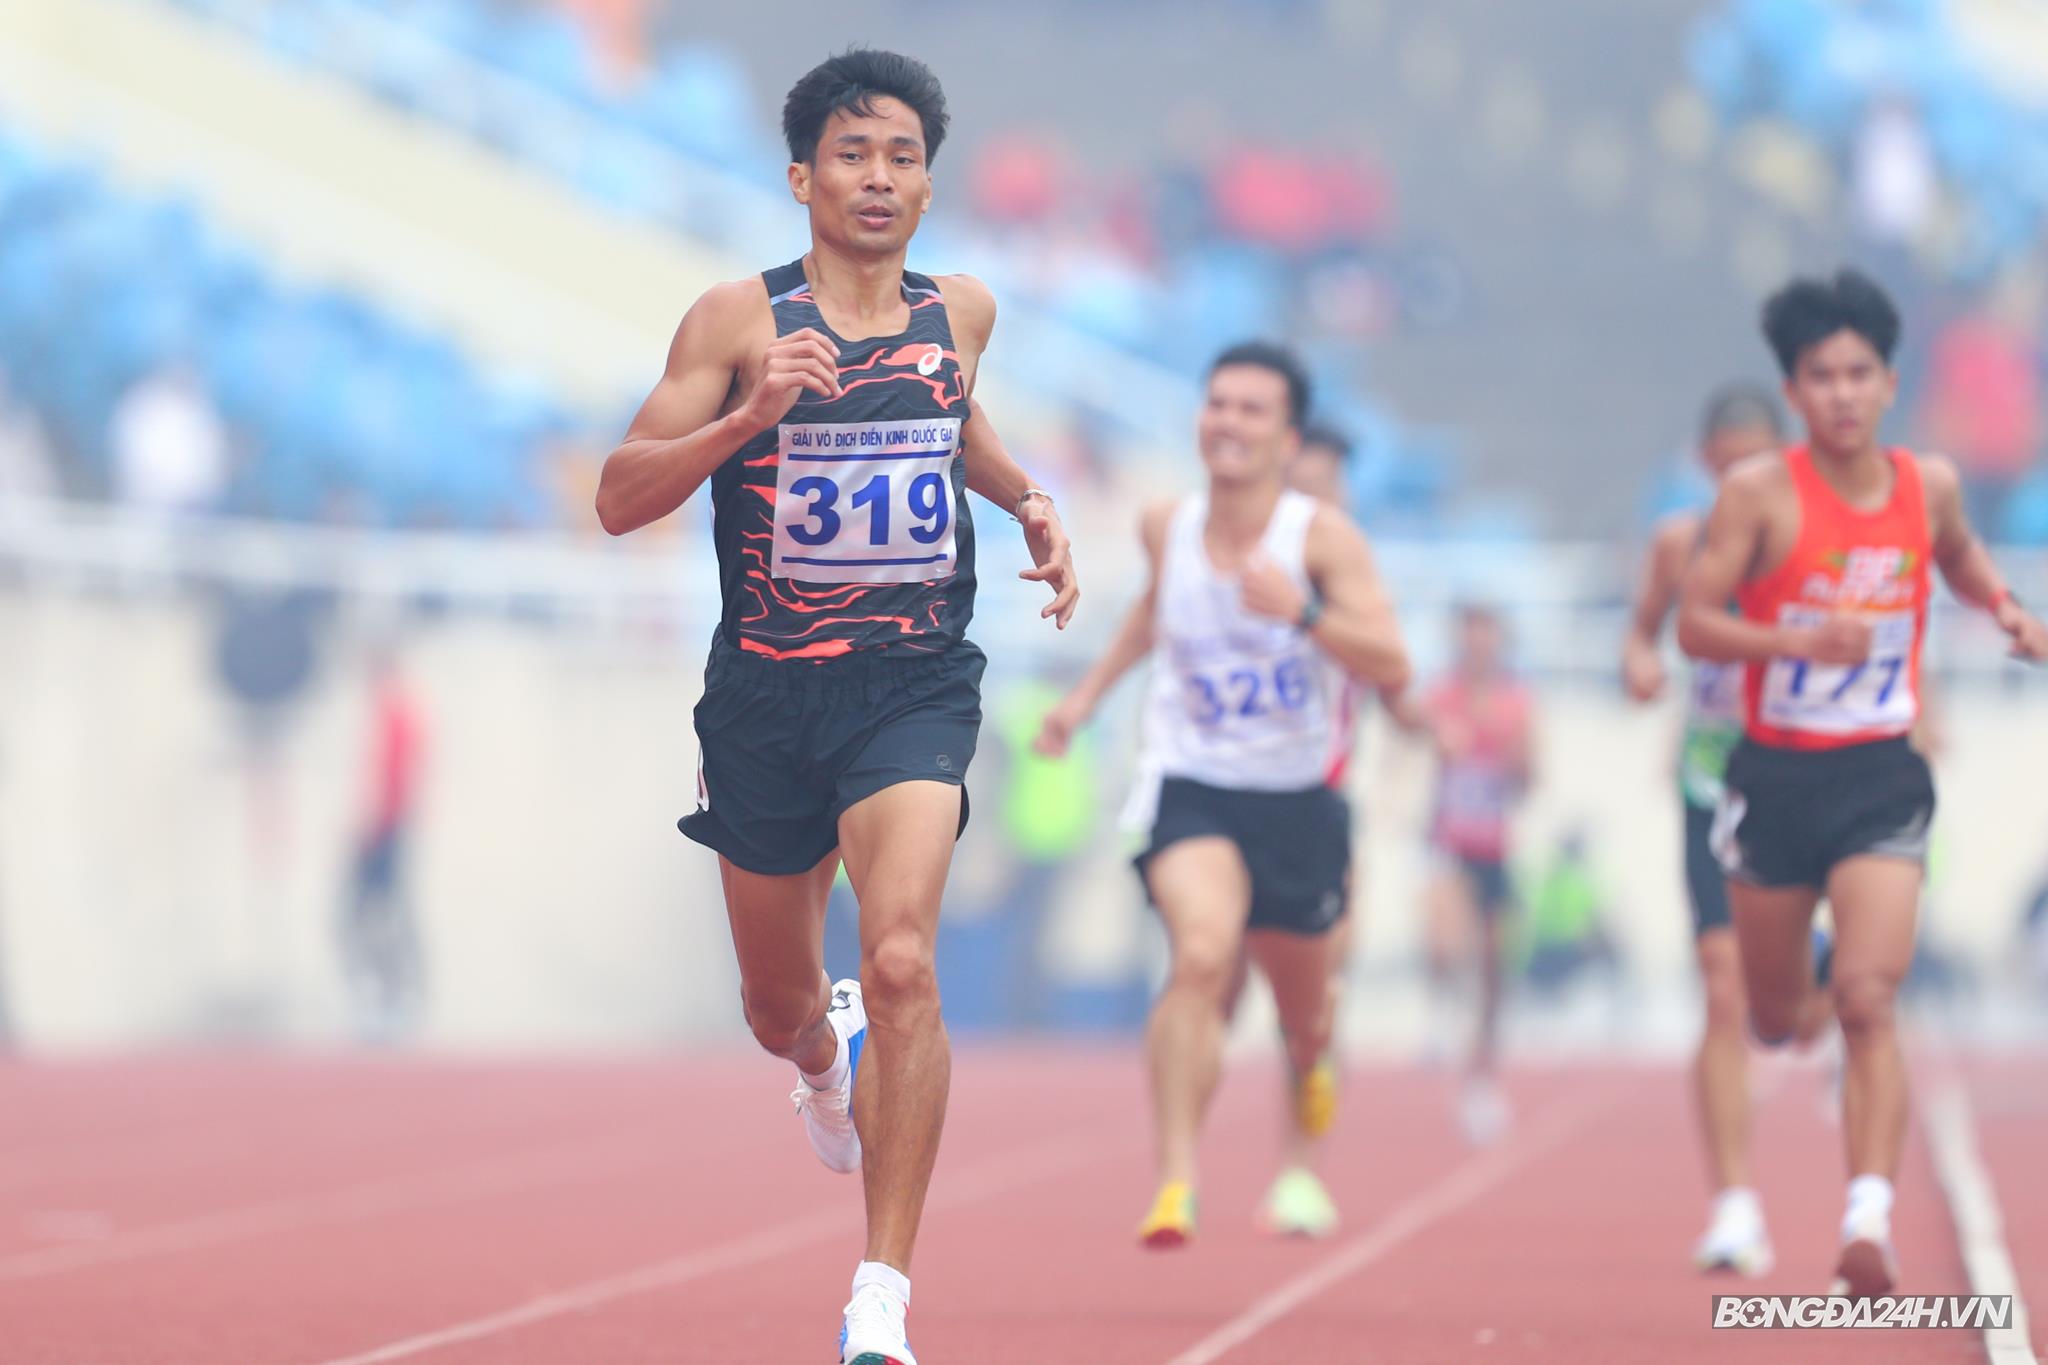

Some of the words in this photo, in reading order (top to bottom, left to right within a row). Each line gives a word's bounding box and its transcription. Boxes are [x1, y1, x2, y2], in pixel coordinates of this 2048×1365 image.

[886, 430, 908, 445] KINH
[912, 424, 936, 444] QUỐC
[940, 427, 953, 442] GIA
[785, 472, 949, 546] 319
[1188, 655, 1311, 727] 326
